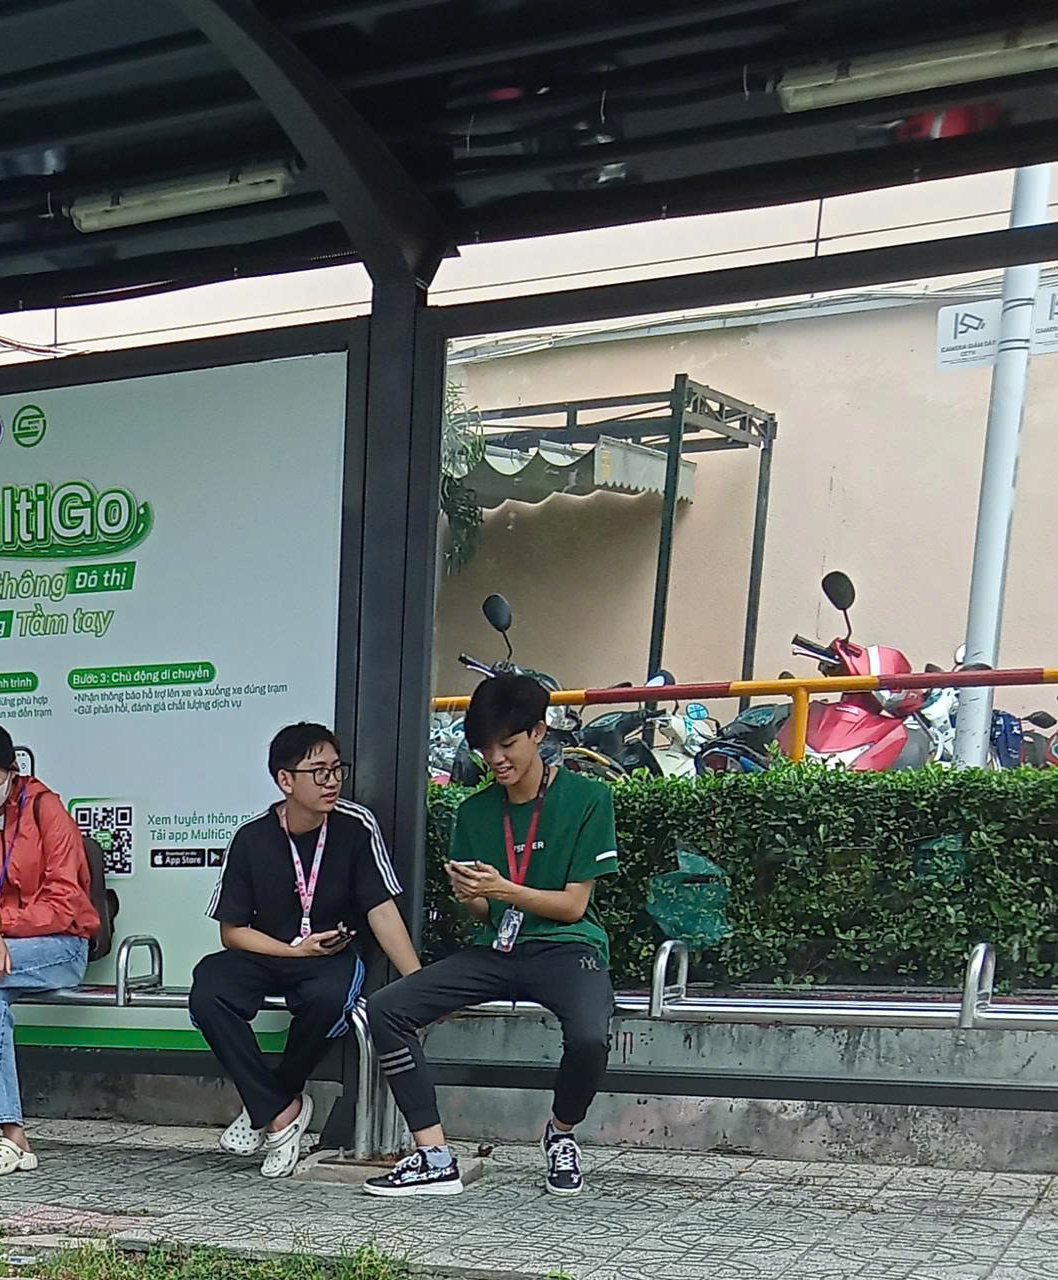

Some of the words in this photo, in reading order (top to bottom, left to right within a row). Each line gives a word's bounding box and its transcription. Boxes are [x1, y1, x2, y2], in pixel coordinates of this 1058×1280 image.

[75, 571, 99, 590] Đô
[102, 567, 127, 591] thị
[16, 603, 68, 636] Tầm
[73, 607, 115, 637] tay
[10, 676, 32, 688] trình
[73, 673, 99, 684] Bước
[100, 673, 110, 683] 3:
[111, 671, 132, 682] Chủ
[133, 669, 159, 683] động
[161, 668, 171, 680] di
[172, 665, 209, 681] chuyển
[17, 696, 31, 708] phù
[33, 695, 48, 707] hợp
[101, 691, 125, 703] thông
[194, 686, 203, 697] và
[204, 684, 231, 697] xuống
[232, 687, 242, 695] xe
[243, 683, 266, 695] đúng
[267, 683, 288, 694] trạm
[8, 710, 17, 718] xe
[93, 703, 113, 715] phản
[131, 702, 152, 713] đánh
[187, 699, 211, 712] lượng
[211, 698, 230, 710] dịch
[231, 699, 242, 709] vụ
[147, 814, 172, 826] Xem
[174, 810, 205, 827] tuyến
[207, 811, 238, 827] thông
[150, 828, 166, 841] Tải
[168, 831, 189, 843] app
[191, 828, 232, 841] MultiGo
[165, 856, 181, 865] App
[181, 855, 201, 865] Store
